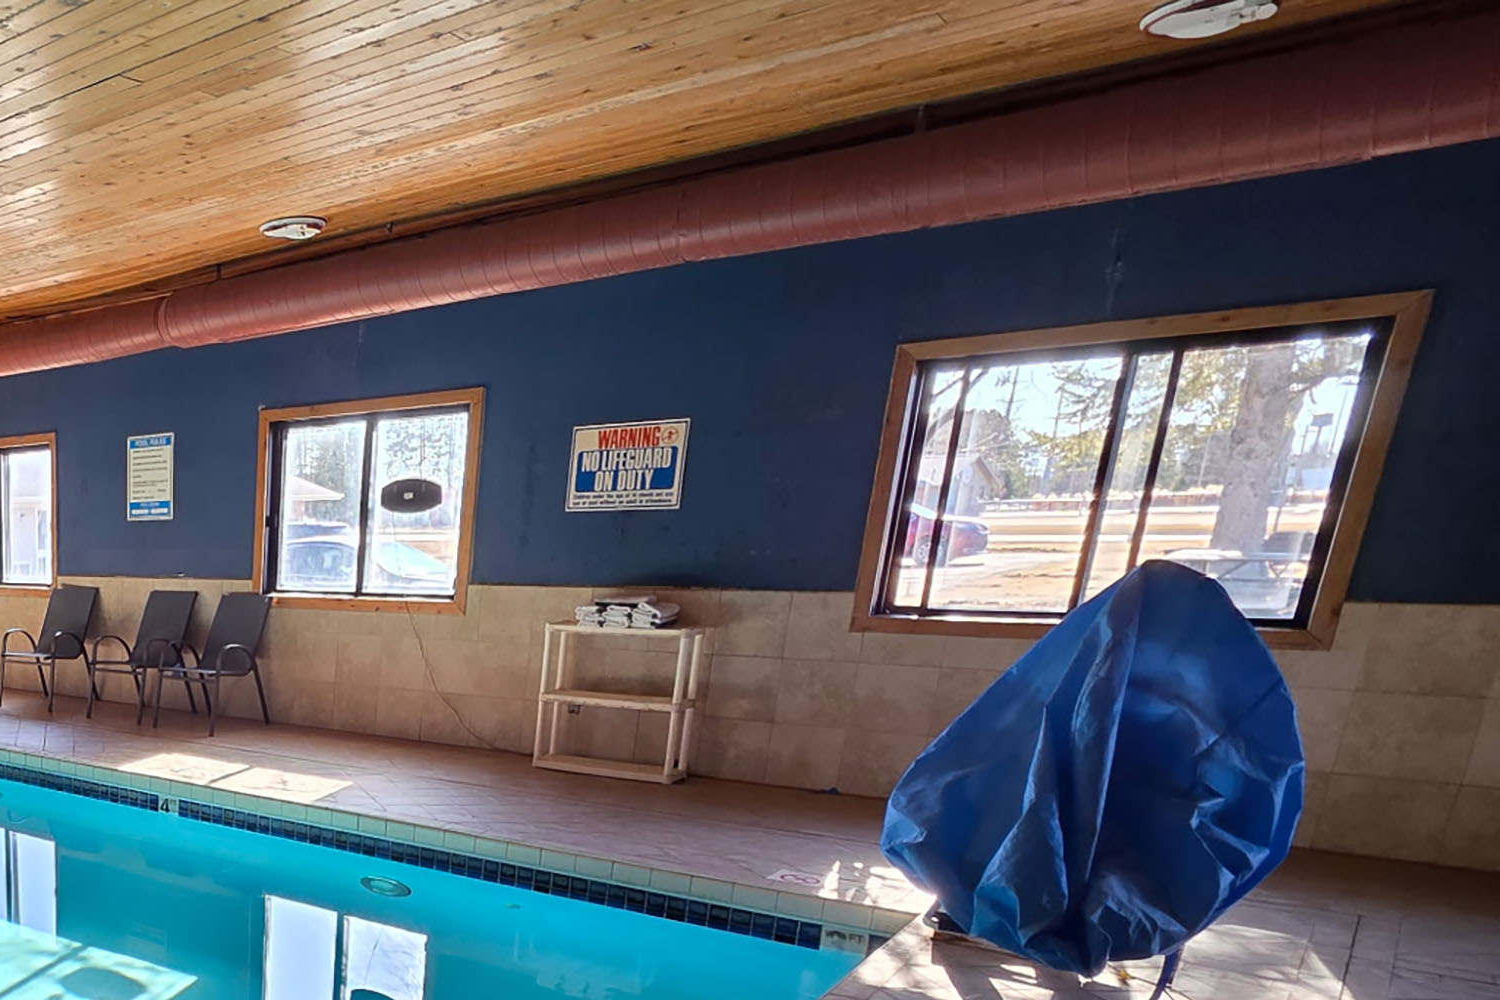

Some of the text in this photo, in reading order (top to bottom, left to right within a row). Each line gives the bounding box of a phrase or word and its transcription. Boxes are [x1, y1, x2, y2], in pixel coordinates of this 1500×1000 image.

[598, 426, 661, 449] WARNING
[581, 447, 672, 472] NO LIFEGUARD
[594, 469, 654, 492] ON DUTY
[160, 798, 170, 813] 4
